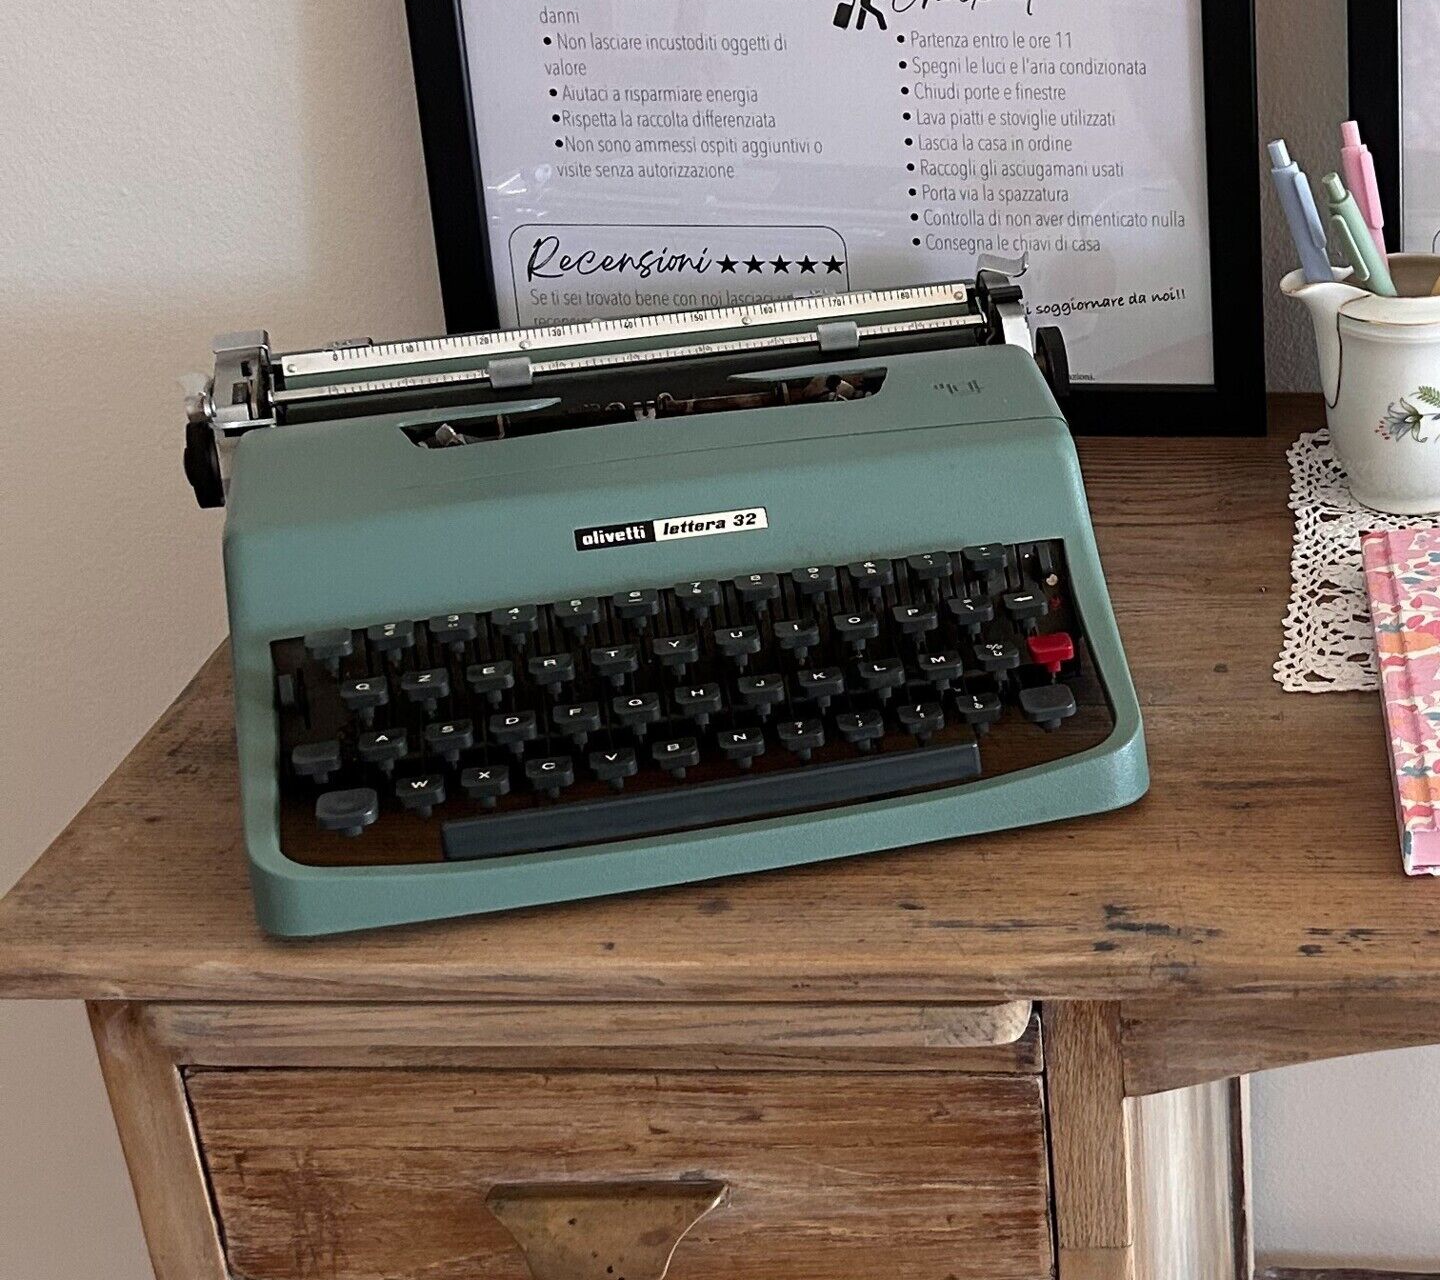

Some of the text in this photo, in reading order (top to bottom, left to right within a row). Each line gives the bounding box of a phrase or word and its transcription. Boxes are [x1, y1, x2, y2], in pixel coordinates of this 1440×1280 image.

[909, 30, 1073, 50] Partenza entro le ore 11
[913, 81, 1068, 103] Chiudi porte e finestre
[526, 235, 714, 283] Recensioni
[1035, 296, 1126, 318] soggiornare
[1128, 292, 1147, 305] da
[582, 513, 757, 546] olivetti lettera 32
